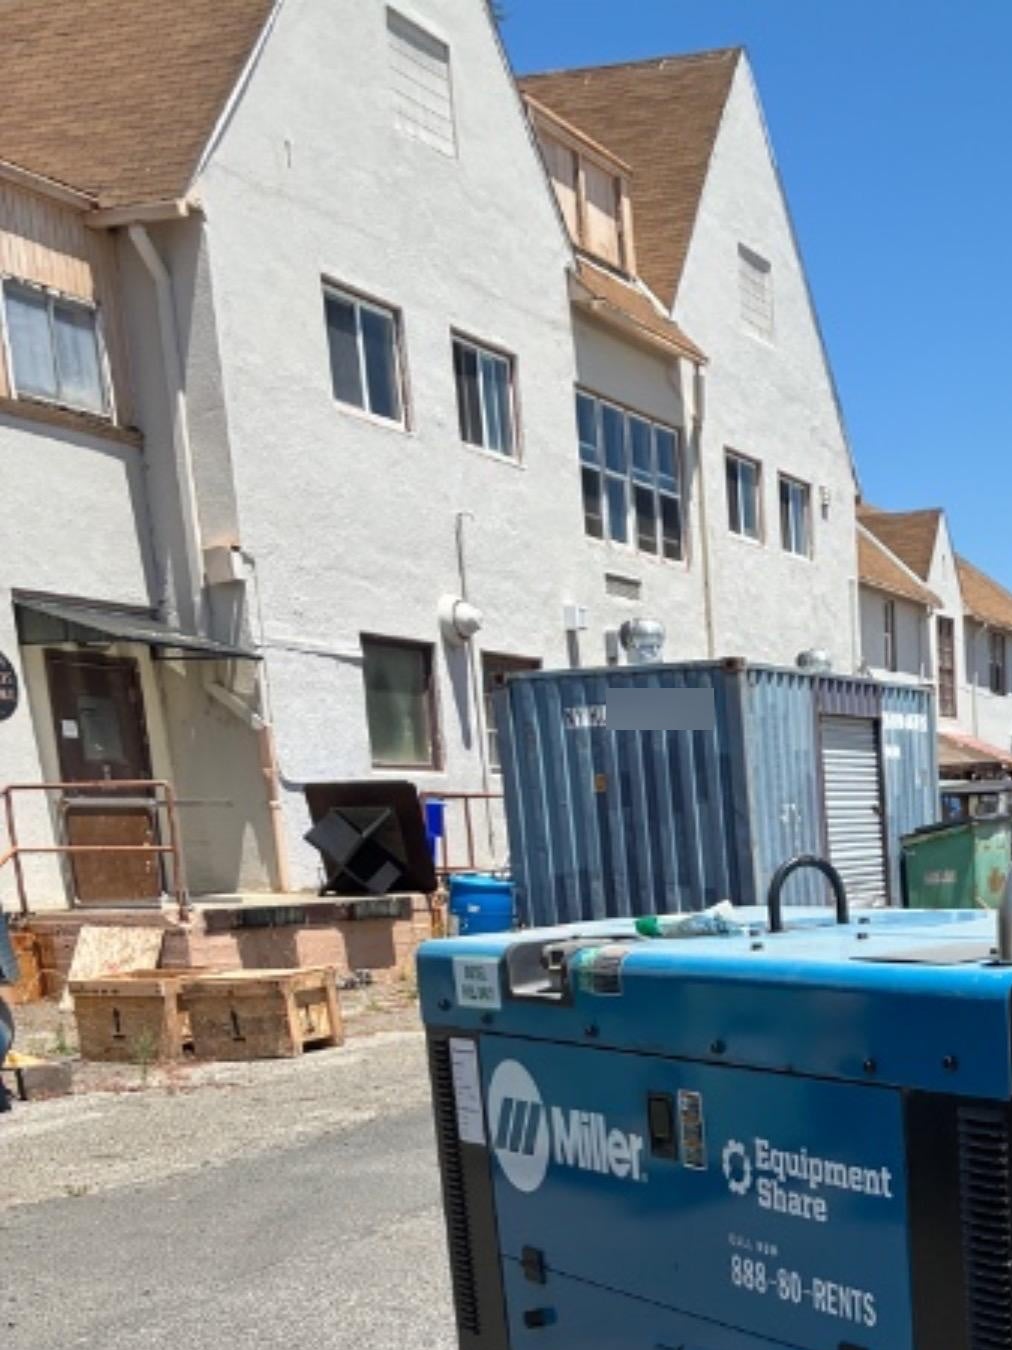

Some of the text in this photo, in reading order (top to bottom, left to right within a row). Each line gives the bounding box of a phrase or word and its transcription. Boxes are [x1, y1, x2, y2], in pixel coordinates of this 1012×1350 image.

[551, 1105, 644, 1181] Miller
[754, 1136, 894, 1198] Equipment
[756, 1177, 829, 1222] Share
[730, 1253, 878, 1328] 888-80-RENTS
